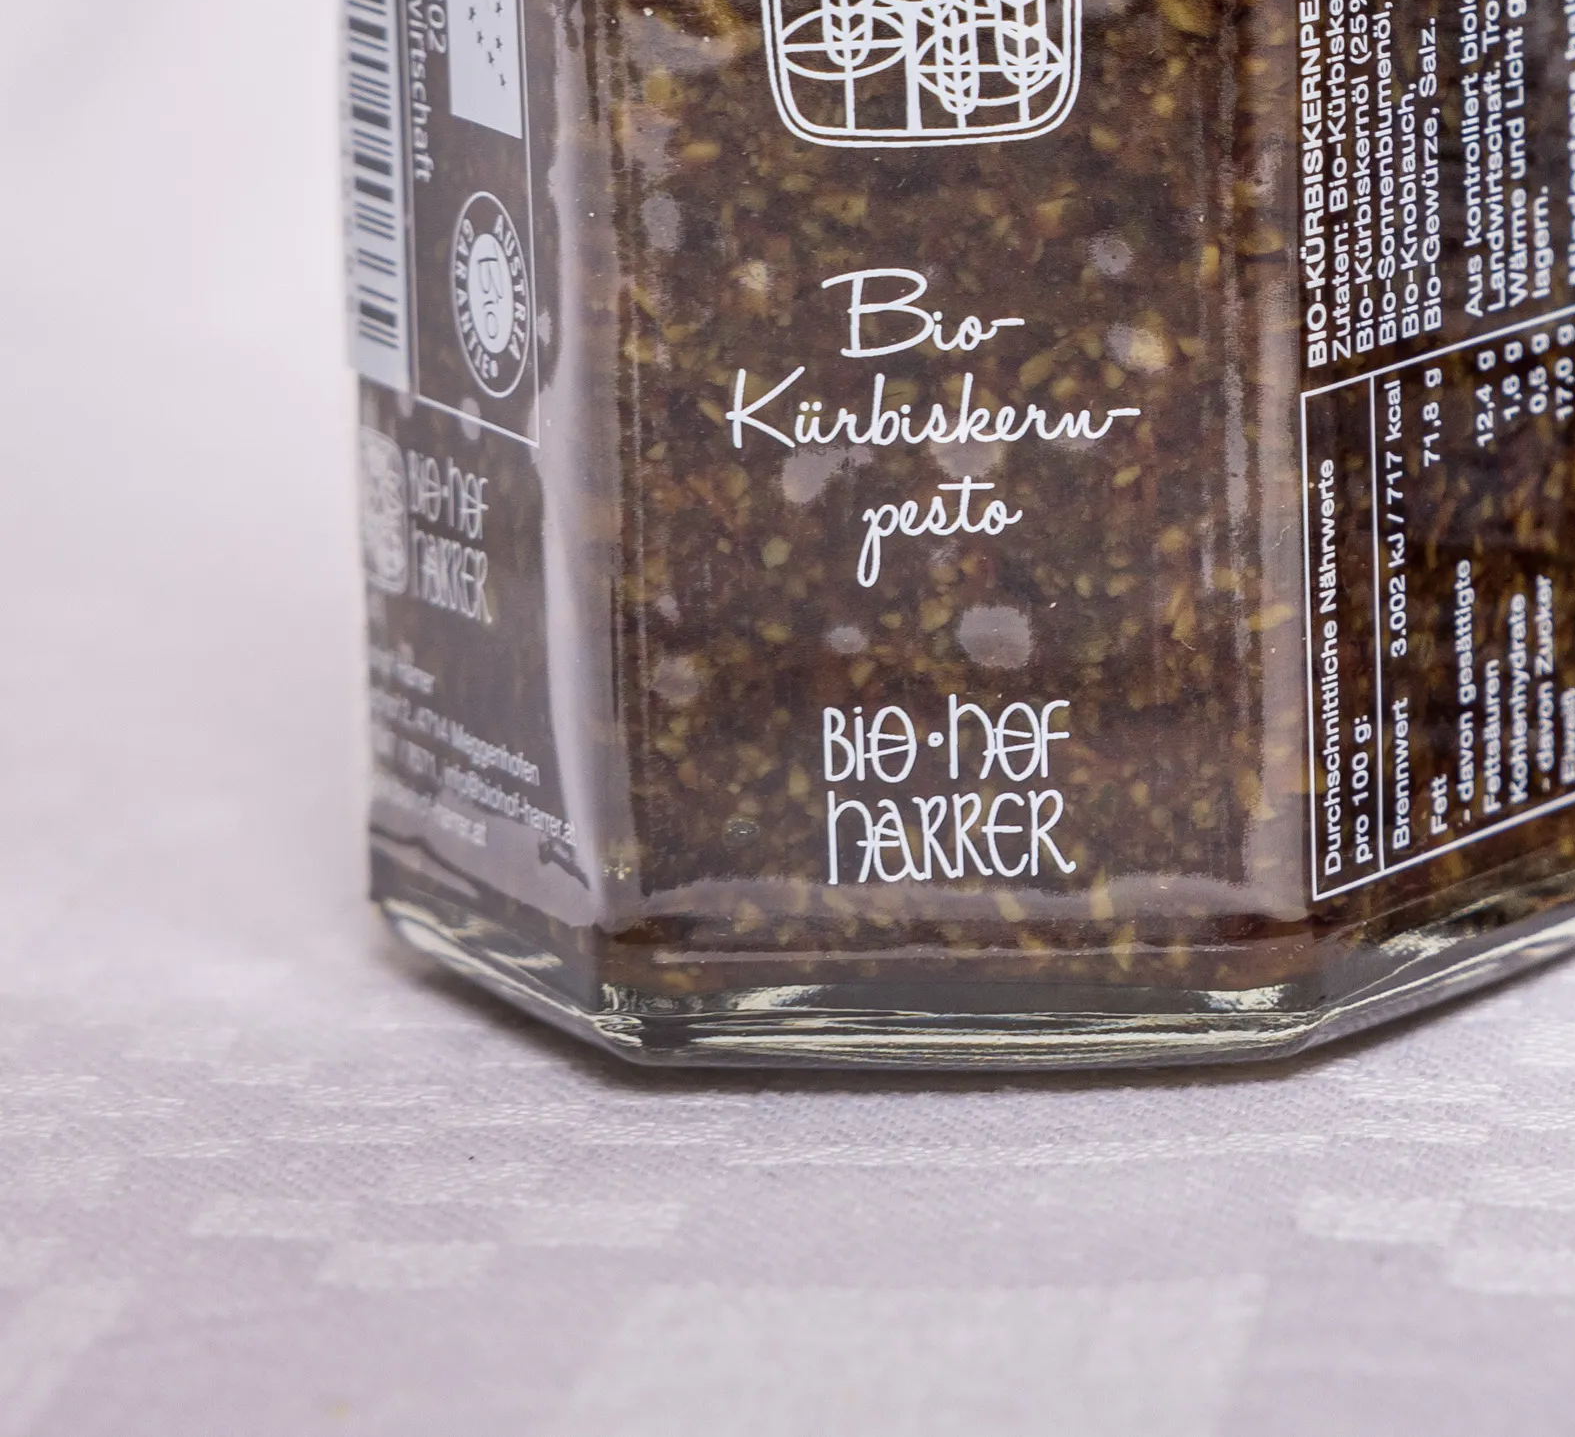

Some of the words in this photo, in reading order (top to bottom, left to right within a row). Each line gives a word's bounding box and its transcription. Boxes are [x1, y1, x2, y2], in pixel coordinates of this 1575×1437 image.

[1419, 17, 1440, 96] Salz.
[1504, 24, 1525, 108] Licht
[1371, 2, 1397, 345] Bio-Sonnenblumenöl,
[1460, 73, 1482, 247] kontrolliert
[1482, 62, 1506, 310] Landwirtschaft.
[1507, 118, 1526, 179] und
[1350, 74, 1375, 351] Bio-Kürbiskernöl
[1398, 82, 1419, 338] Bio-Knoblauch,
[1421, 106, 1442, 331] Bio-Gewürze,
[1507, 189, 1528, 306] Wärme
[1531, 186, 1554, 298] lagern.
[493, 218, 526, 361] AUSTRIA
[821, 267, 1026, 358] Bio-
[1330, 222, 1352, 361] Zutaten:
[1464, 255, 1484, 316] Aus
[1425, 367, 1442, 388] g
[1477, 350, 1496, 371] g
[725, 366, 1141, 449] Kürbiskern-
[1383, 380, 1402, 441] kcal
[1423, 402, 1442, 467] 71,8
[1475, 383, 1495, 447] 12,4
[1385, 451, 1404, 504] 717
[857, 475, 1023, 588] pesto
[1317, 459, 1338, 613] Nährwerte
[1387, 532, 1406, 567] kJ
[1389, 577, 1408, 657] 3.002
[1455, 560, 1477, 705] gesättigte
[1534, 575, 1553, 677] Zucker
[1351, 715, 1372, 742] g:
[1482, 659, 1501, 813] Fettsäuren
[1509, 593, 1530, 804] Kohlenhydrate
[1536, 681, 1554, 772] davon
[450, 721, 540, 786] Meggenhofen
[1320, 621, 1343, 875] Durchschnittliche
[1352, 751, 1370, 805] 100
[1391, 697, 1411, 849] Brennwert
[1456, 712, 1474, 802] davon
[827, 789, 1076, 884] HARRER
[1353, 814, 1373, 863] pro
[1430, 773, 1449, 834] Fett
